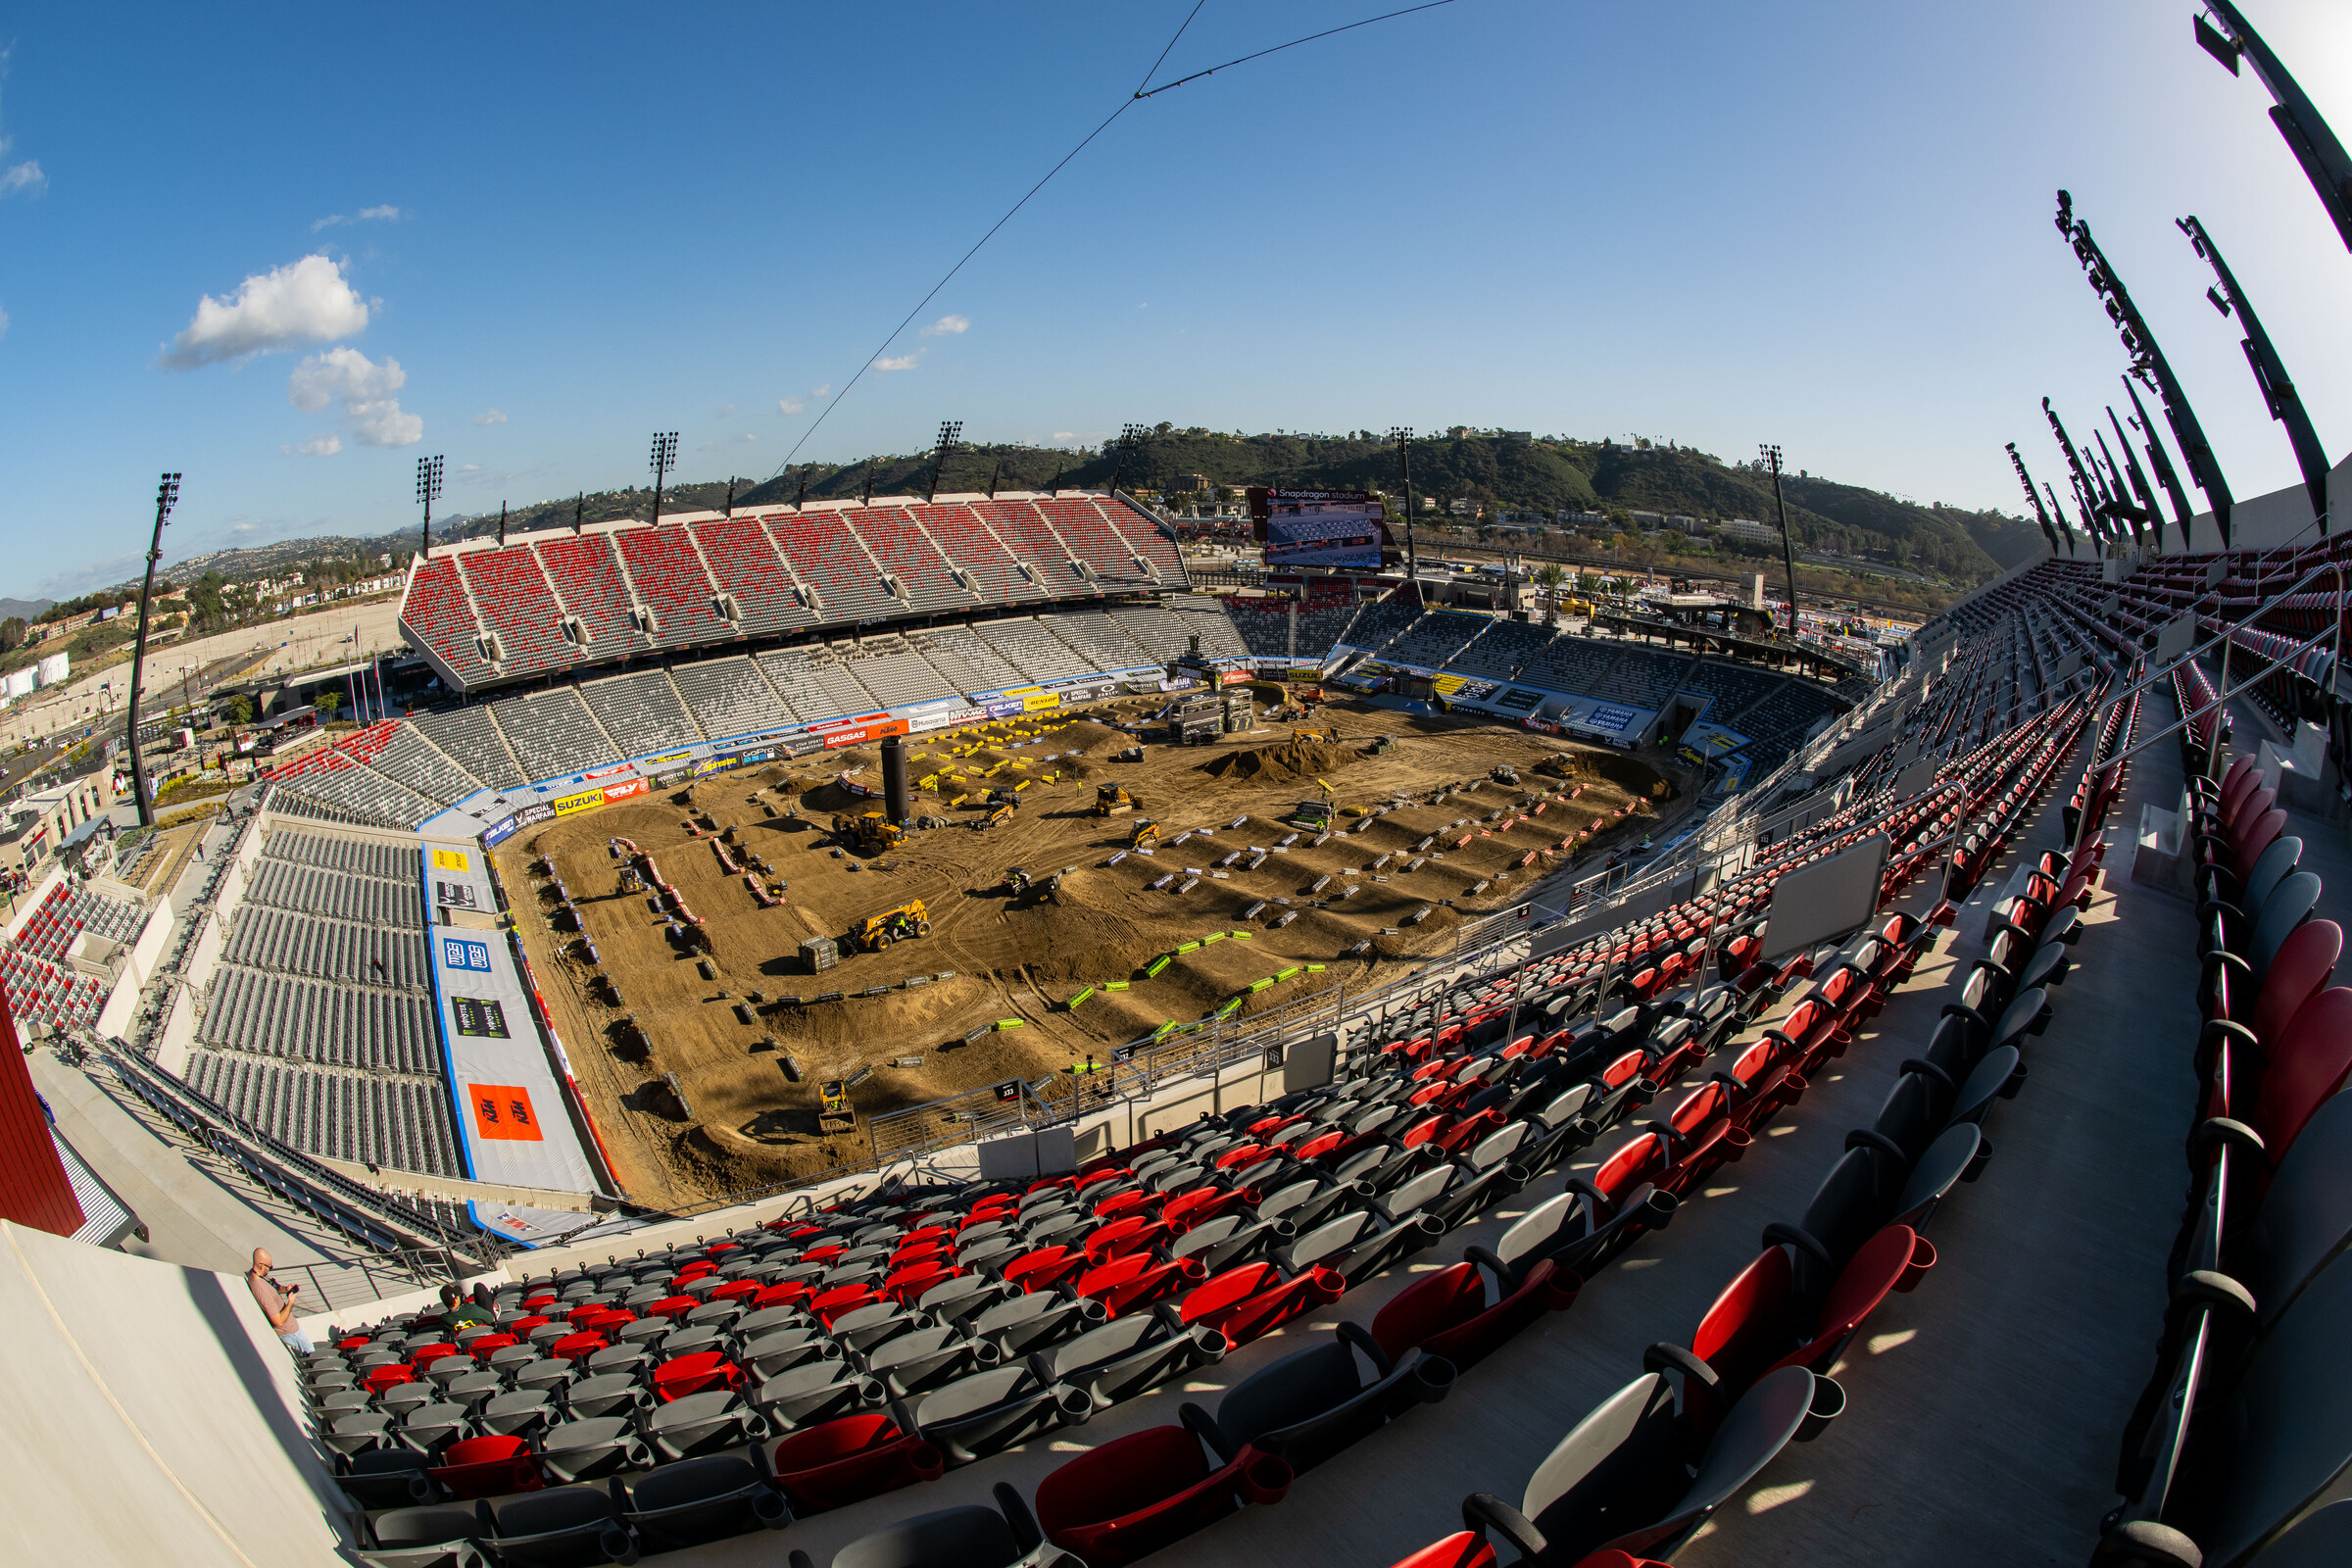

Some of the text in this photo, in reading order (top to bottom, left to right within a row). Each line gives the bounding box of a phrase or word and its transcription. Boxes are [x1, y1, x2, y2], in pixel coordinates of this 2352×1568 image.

[1279, 489, 1330, 499] Snapdragon
[989, 701, 1022, 712] FALKEN
[1607, 708, 1633, 717] YAMAHA
[918, 716, 946, 726] Husqvarna
[1596, 719, 1623, 729] YAMAHA
[1601, 713, 1628, 723] YAMAHA
[827, 730, 865, 745] GASGAS
[742, 747, 774, 758] GoPro
[658, 770, 685, 782] MONSTER
[557, 793, 603, 811] SUZUKI
[524, 804, 551, 816] SPECIAL
[526, 808, 556, 823] WARFARE
[486, 818, 514, 840] FALKEN
[460, 1004, 470, 1028] MONSTER
[484, 1005, 497, 1031] MONSTER
[1268, 1051, 1280, 1064] 333
[1003, 1088, 1014, 1097] 333
[482, 1099, 499, 1123] KTM
[510, 1100, 530, 1125] KTM
